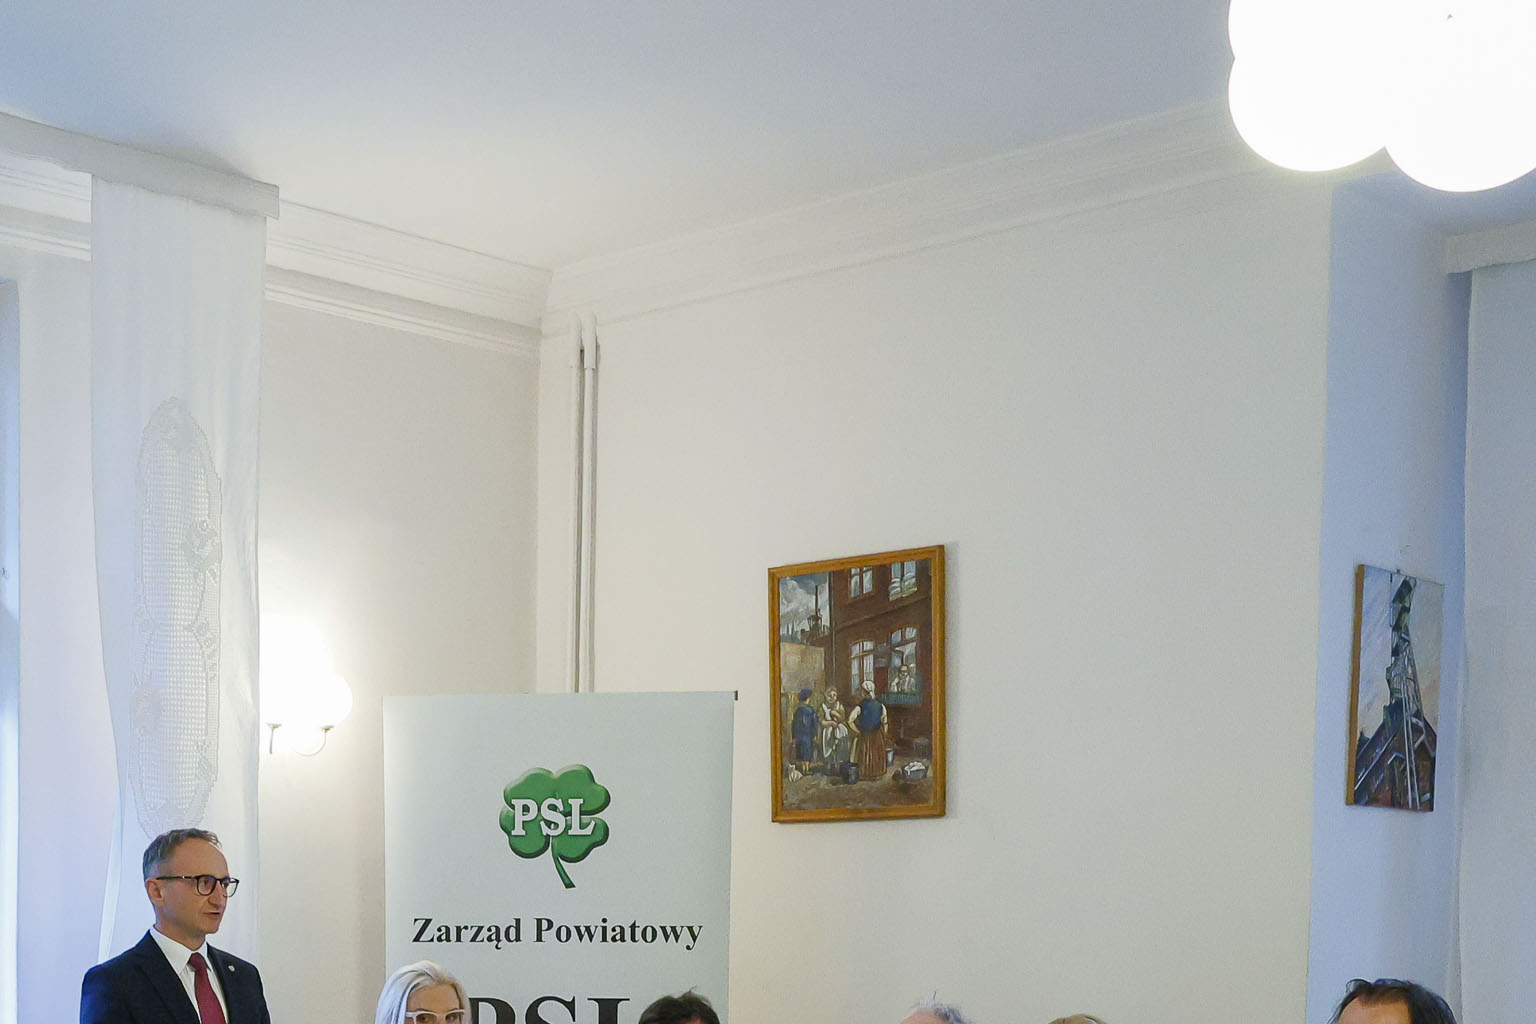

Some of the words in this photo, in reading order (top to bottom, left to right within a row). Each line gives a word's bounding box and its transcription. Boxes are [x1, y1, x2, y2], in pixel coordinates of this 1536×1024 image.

[511, 797, 596, 836] PSL
[412, 918, 522, 950] Zarząd
[533, 917, 703, 951] Powiatowy
